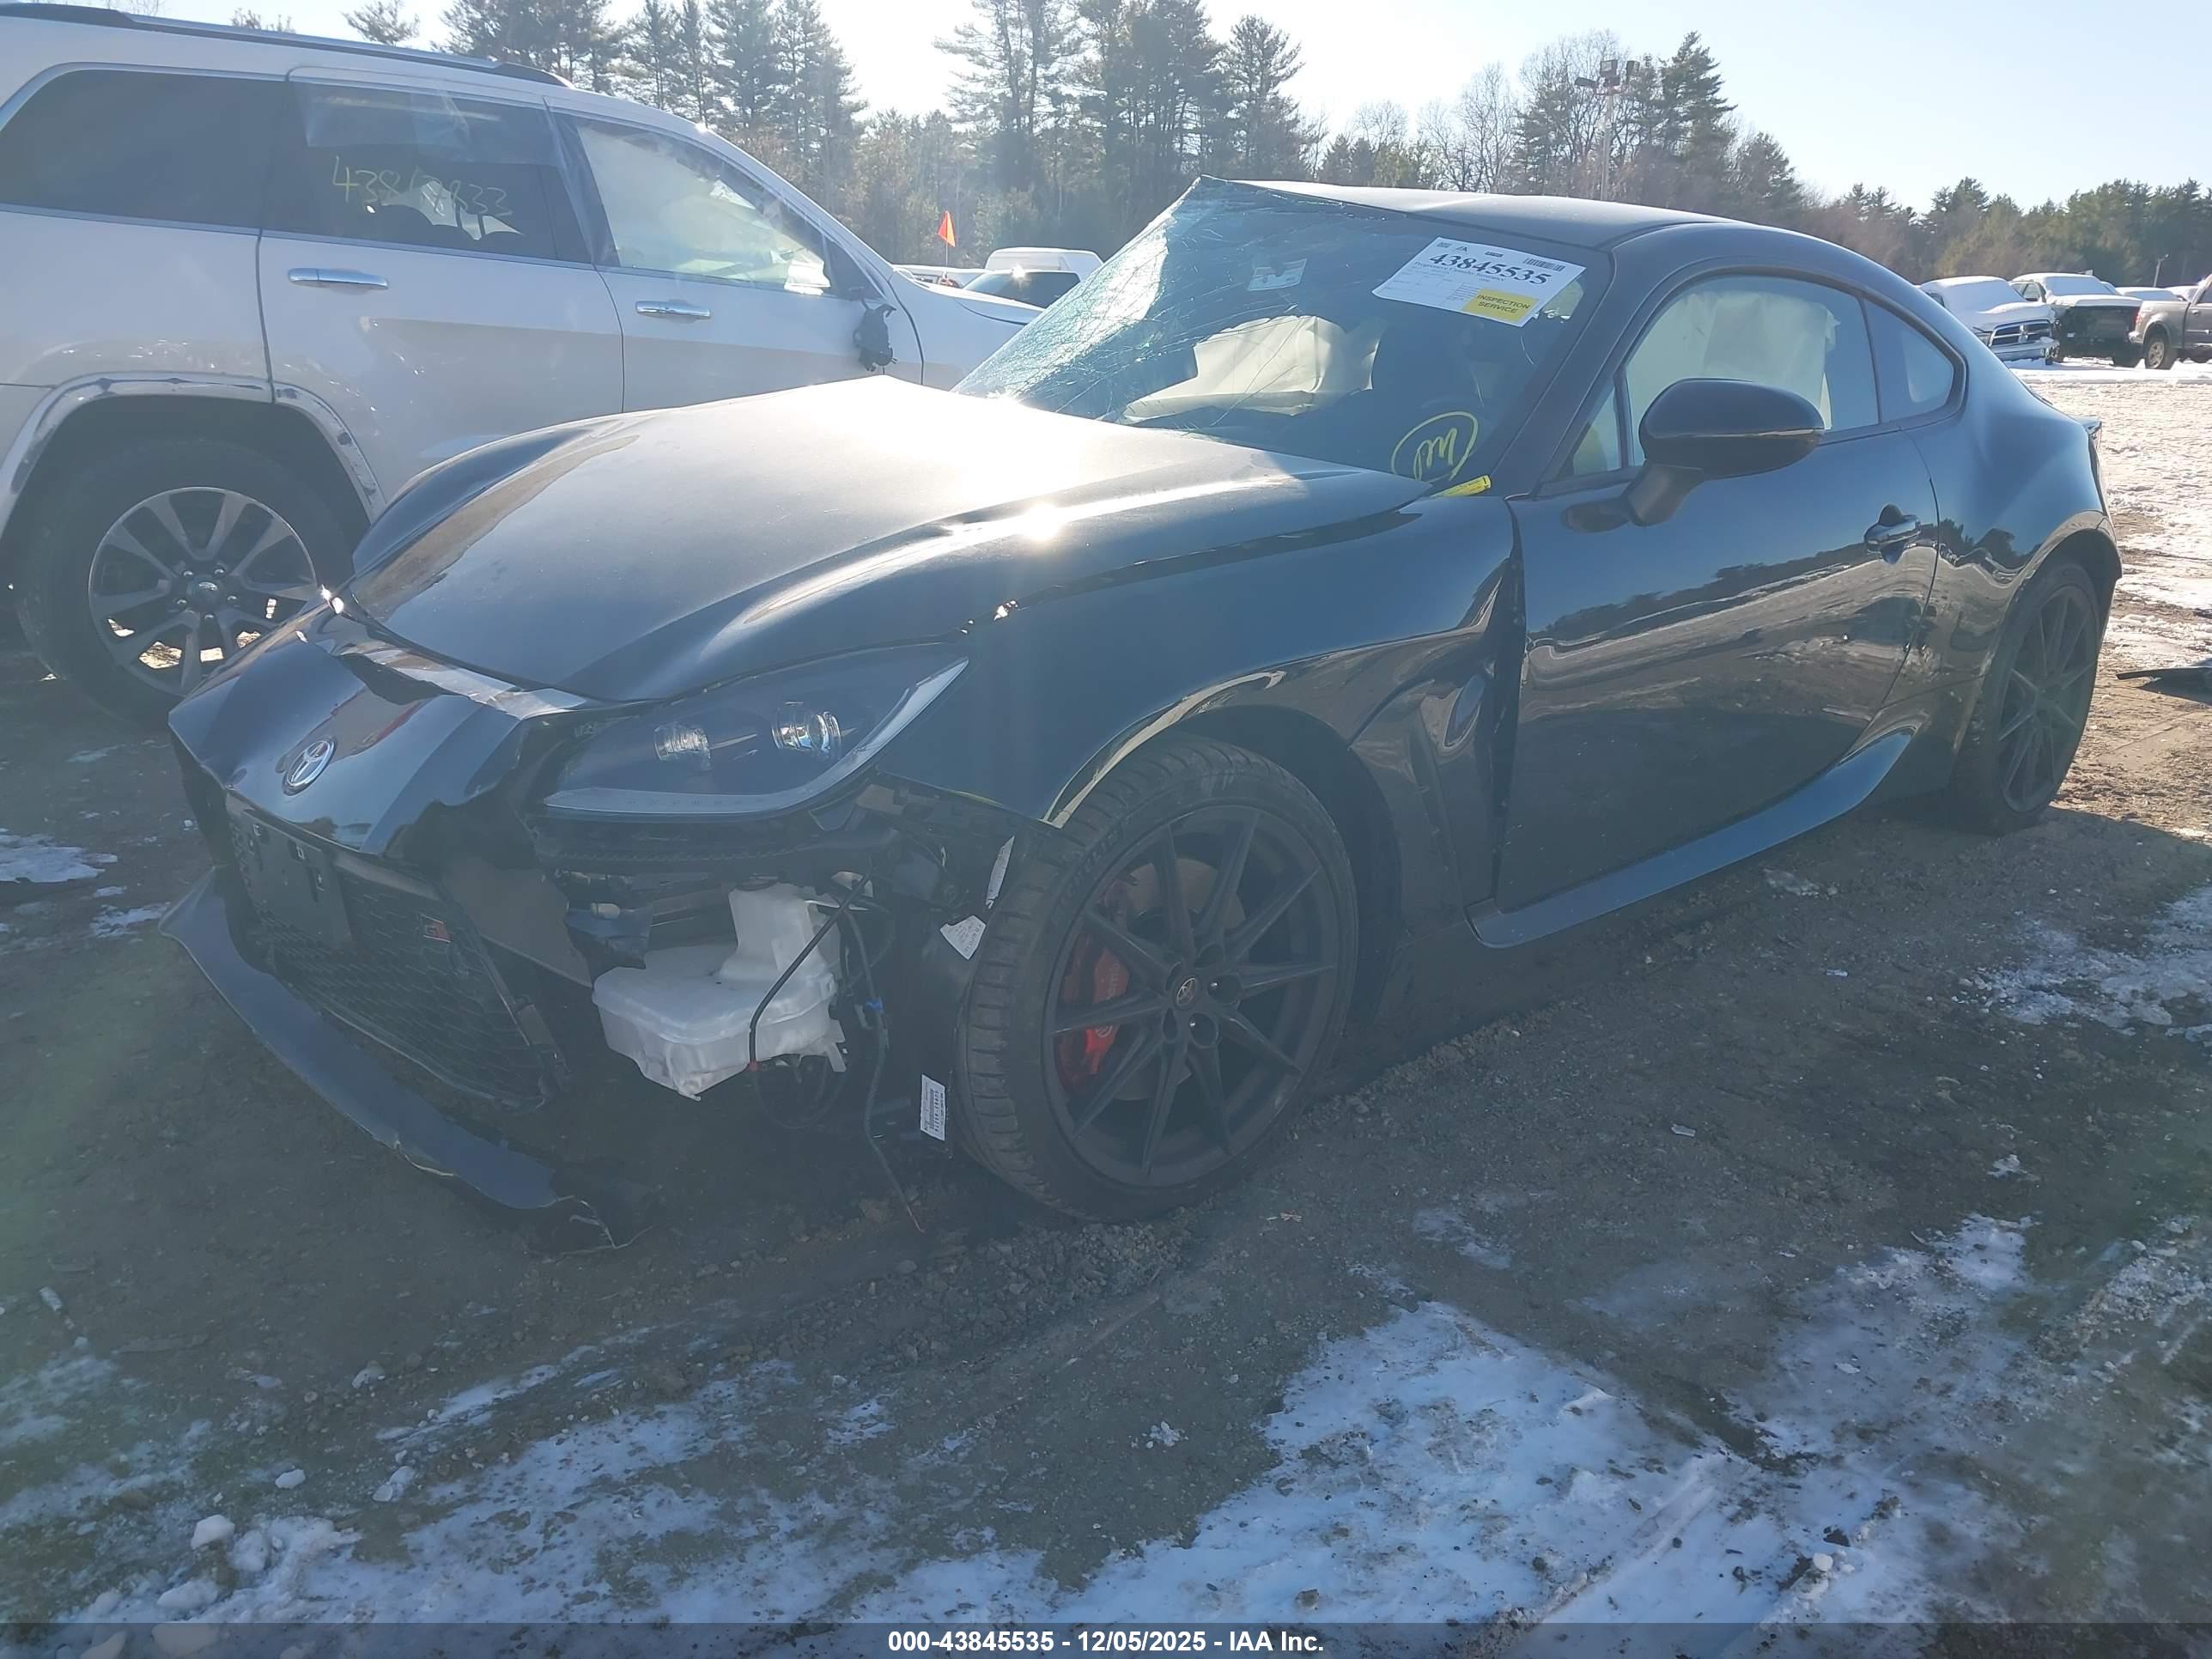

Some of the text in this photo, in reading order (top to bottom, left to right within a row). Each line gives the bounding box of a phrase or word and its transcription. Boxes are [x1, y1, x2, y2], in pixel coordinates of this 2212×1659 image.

[1429, 252, 1553, 285] 43845535
[1476, 294, 1531, 310] INSPECTION
[1478, 301, 1519, 314] SERVICE
